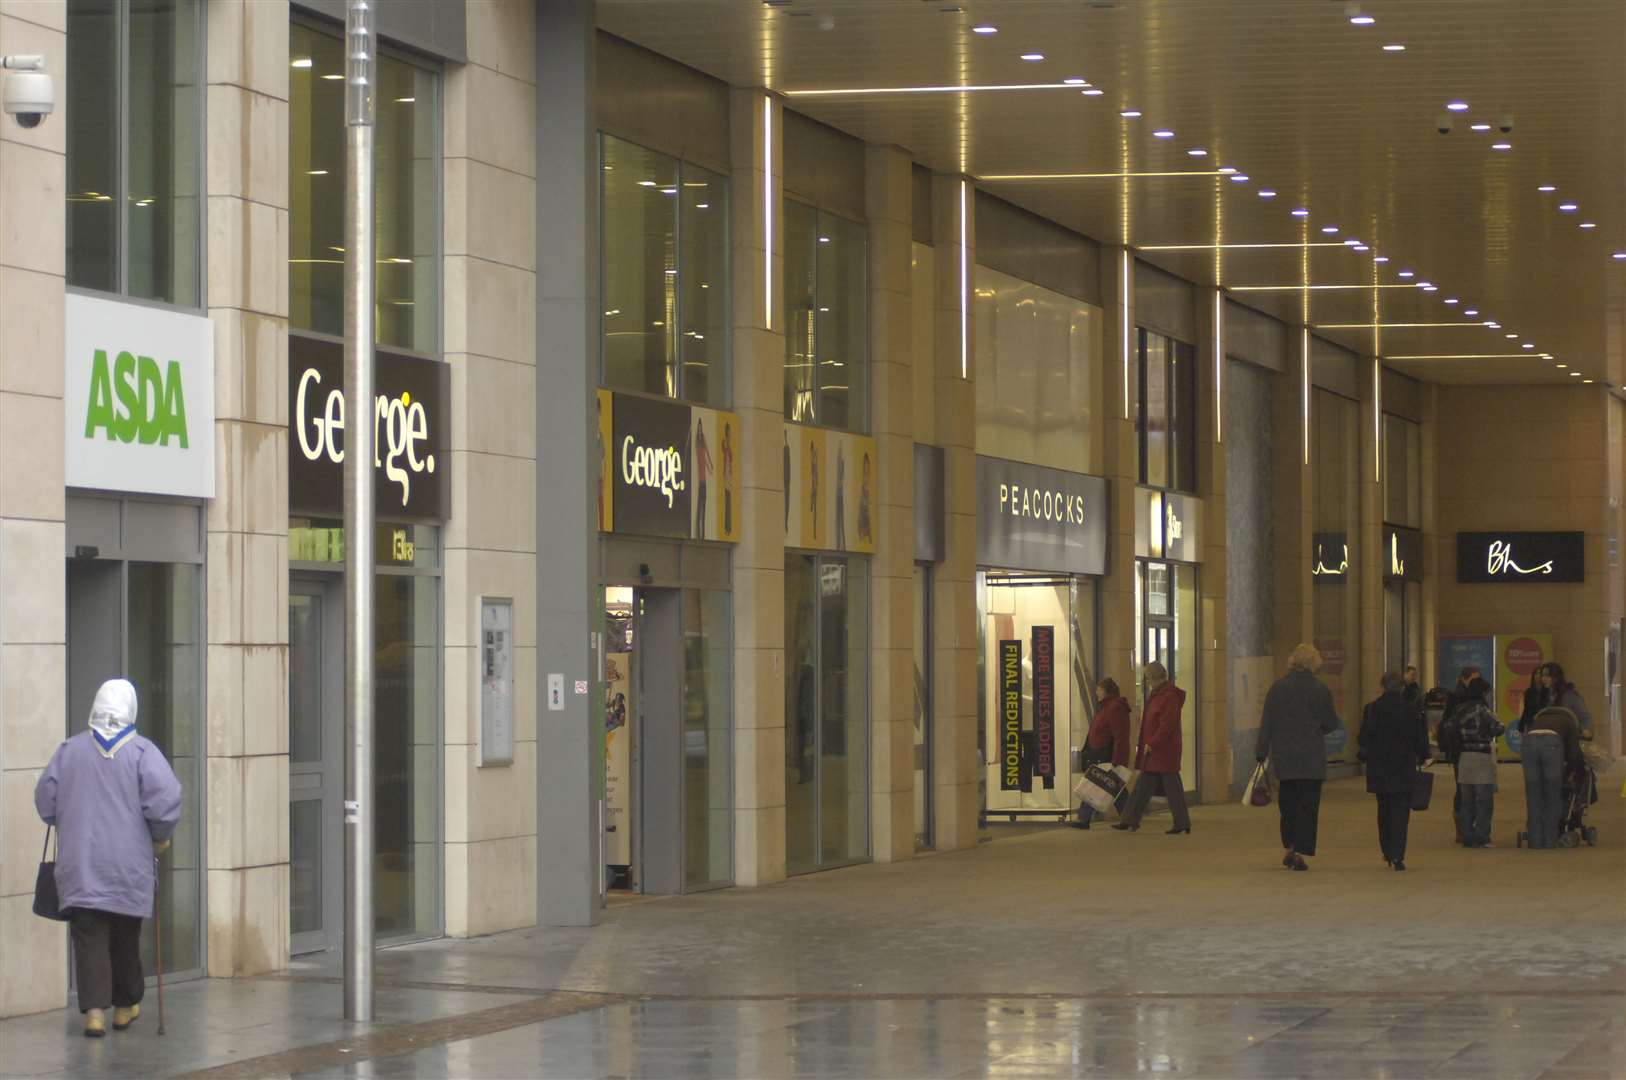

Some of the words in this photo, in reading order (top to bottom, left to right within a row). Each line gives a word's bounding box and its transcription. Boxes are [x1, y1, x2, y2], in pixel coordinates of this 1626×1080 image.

[84, 348, 189, 450] ASDA
[296, 367, 435, 507] Gerge.
[999, 484, 1085, 525] PEACOCKS
[1487, 540, 1554, 575] Bhs
[1005, 644, 1018, 688] FINAL
[1036, 629, 1050, 672] MORE
[1037, 675, 1050, 717] LINES
[1005, 693, 1019, 786] REDUCTIONS
[1037, 720, 1051, 774] ADDED
